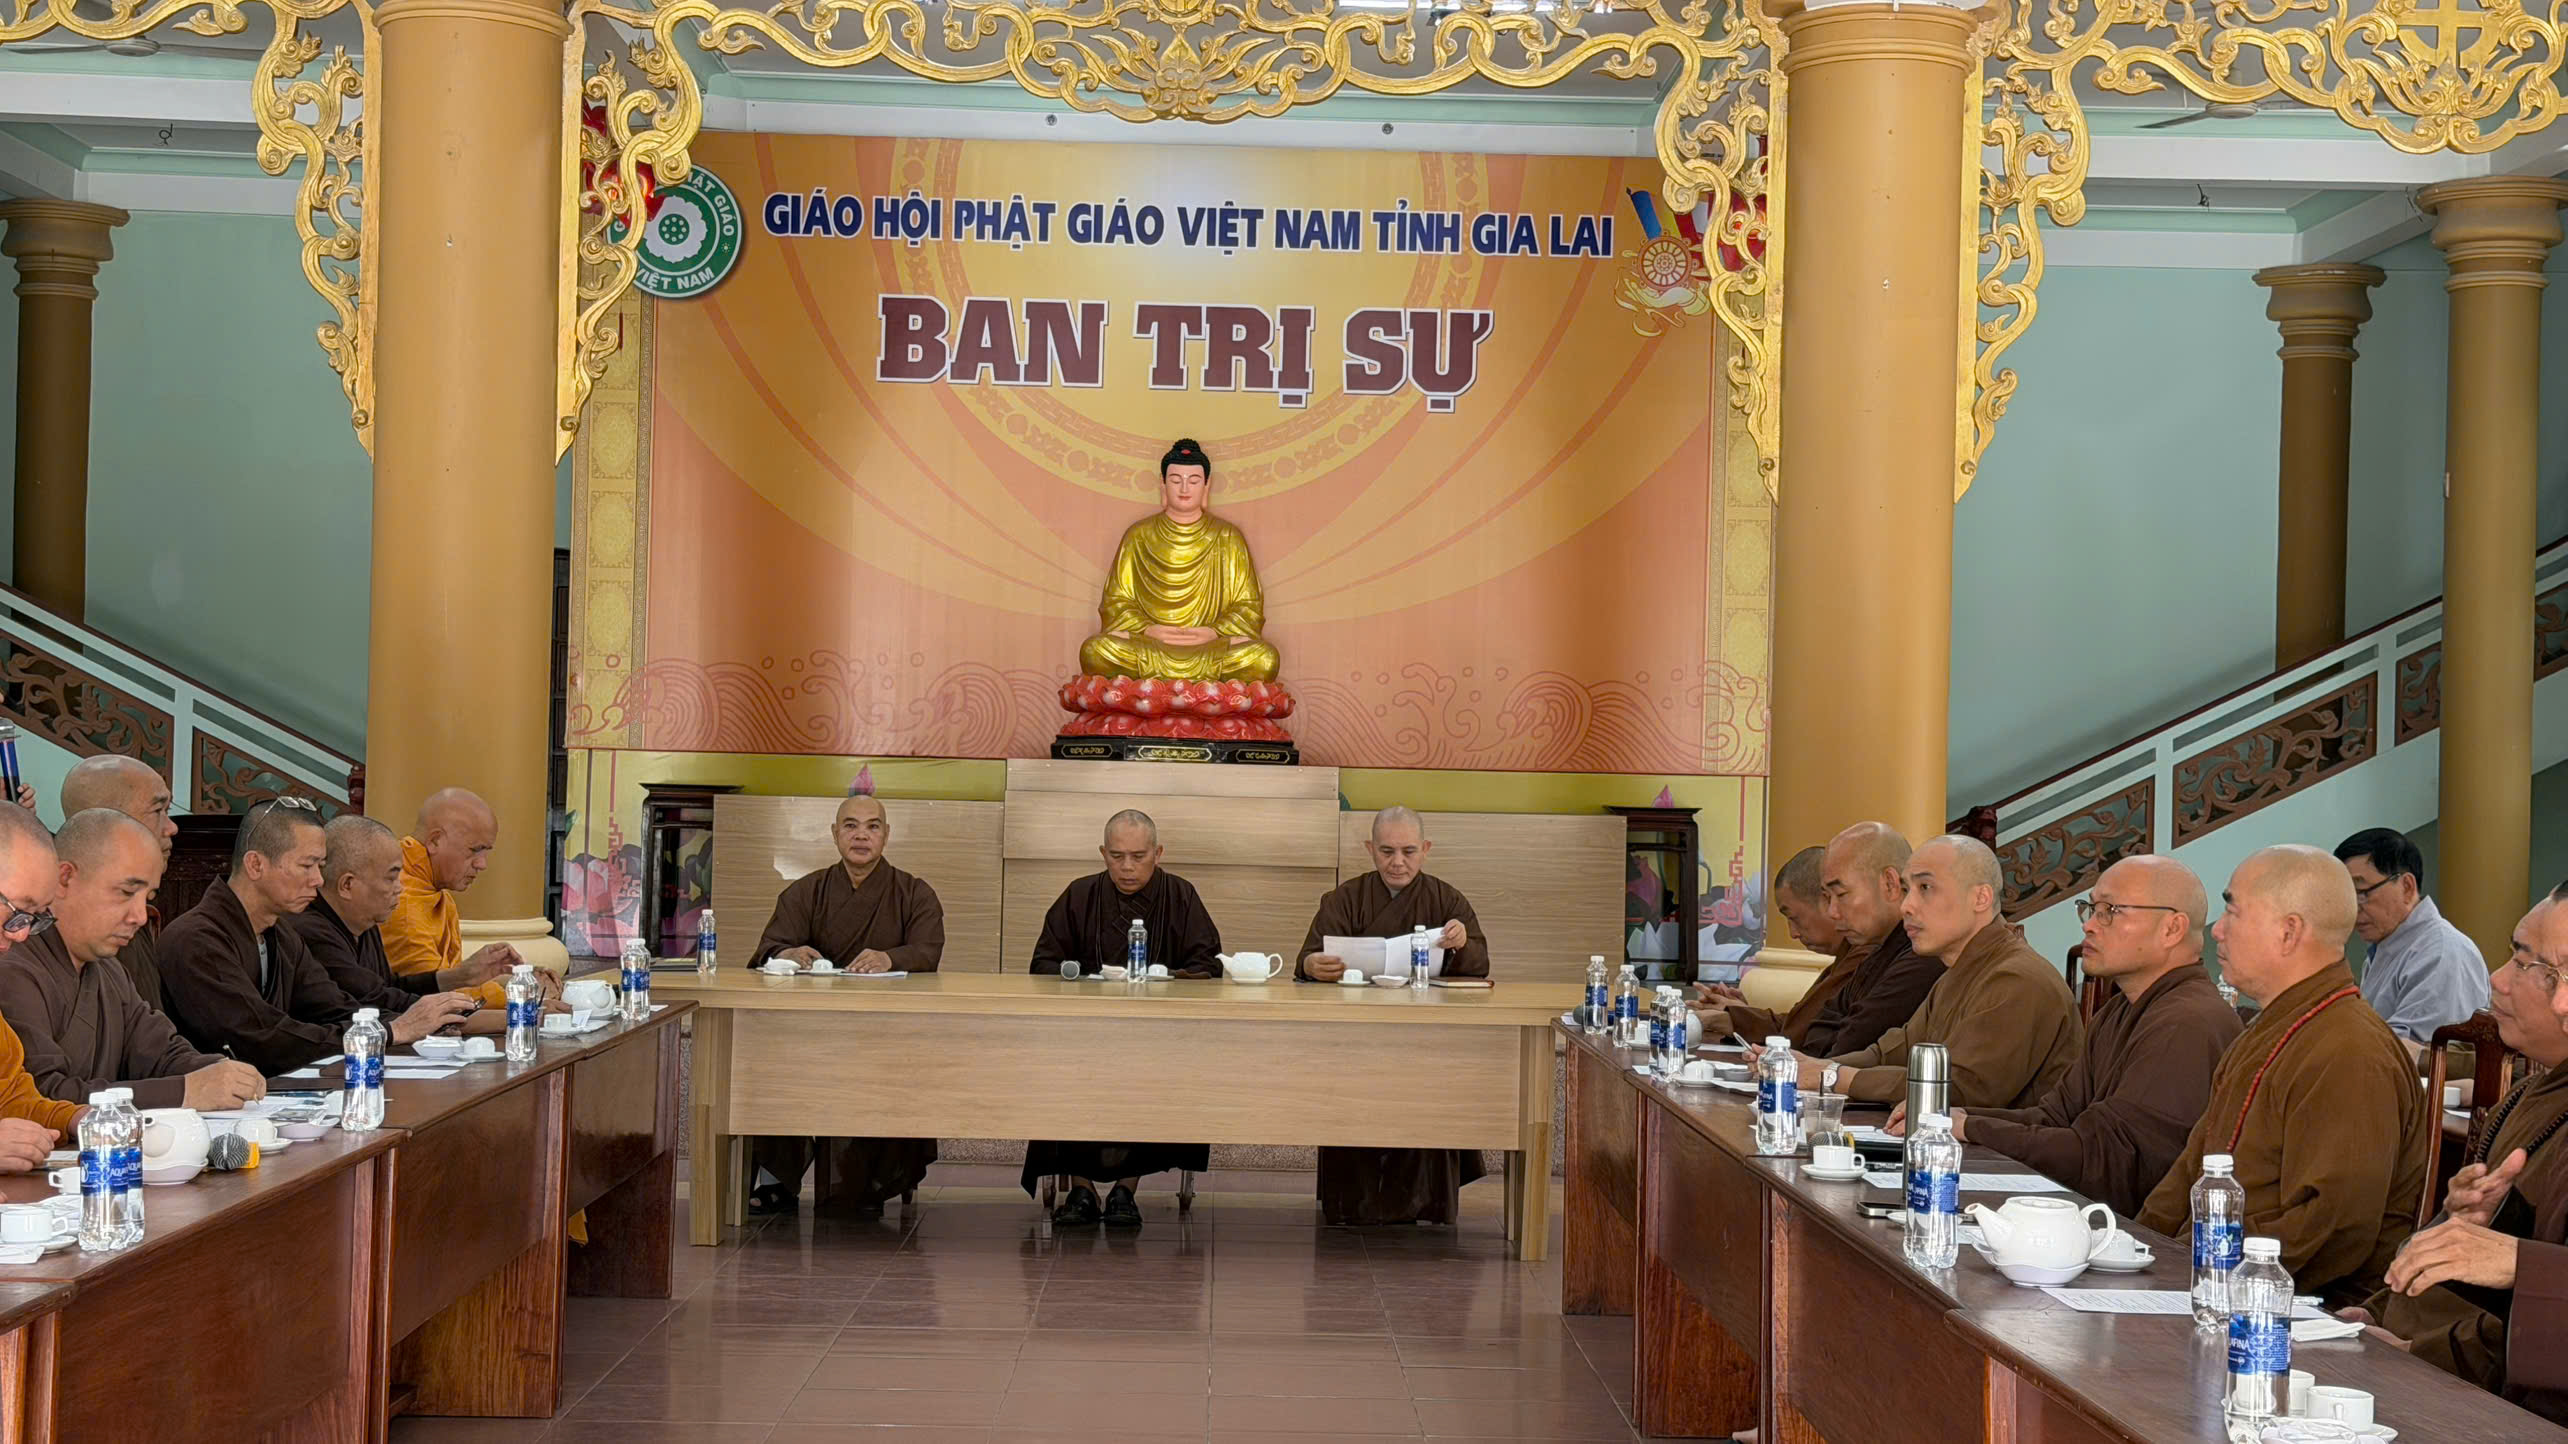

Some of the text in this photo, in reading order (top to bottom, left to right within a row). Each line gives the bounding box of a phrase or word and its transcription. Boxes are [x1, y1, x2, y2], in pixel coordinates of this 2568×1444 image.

[714, 194, 737, 237] GIÁO
[763, 188, 1613, 257] GIÁO HỘI PHẬT GIÁO VIỆT NAM TỈNH GIA LAI
[676, 266, 715, 290] NAM
[879, 296, 1493, 411] BAN TRỊ SỰ
